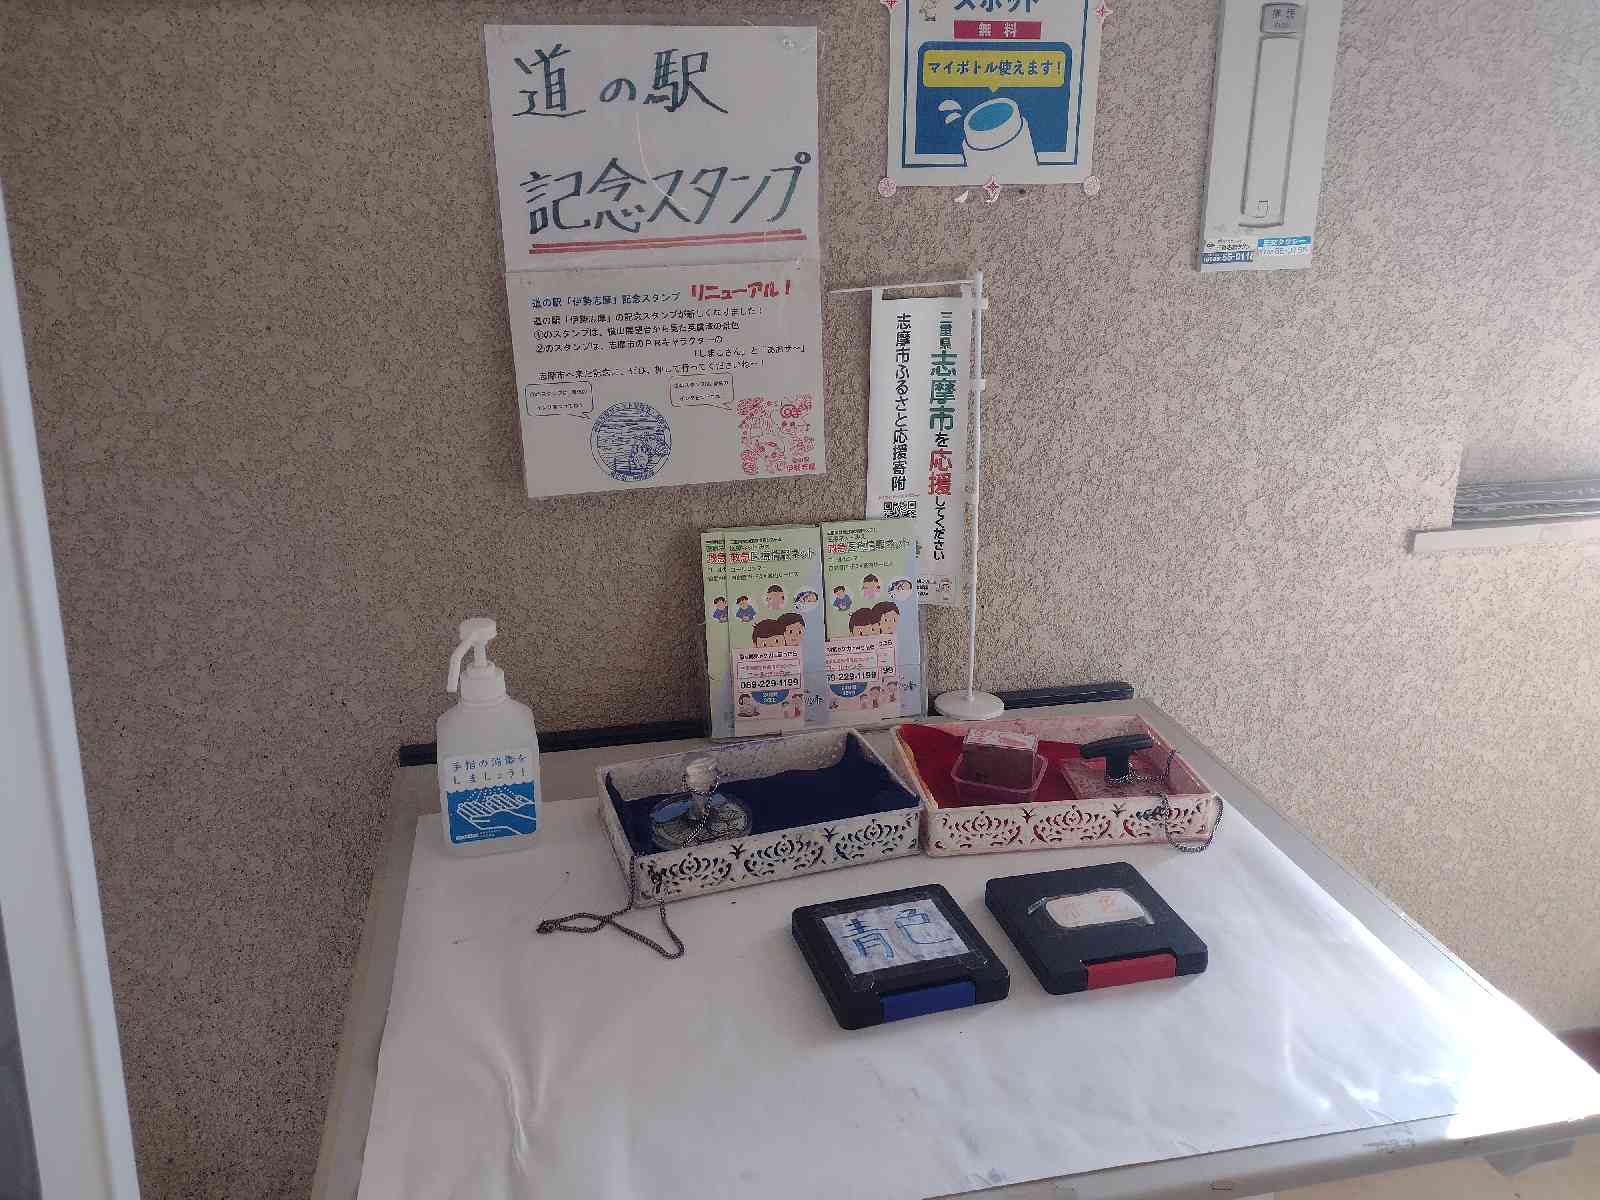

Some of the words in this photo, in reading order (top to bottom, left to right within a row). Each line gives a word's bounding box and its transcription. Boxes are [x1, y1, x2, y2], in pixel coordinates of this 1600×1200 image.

[512, 43, 728, 118] 道の駅
[927, 60, 1062, 75] マイボトル使えます！
[519, 151, 812, 235] 記念スタンプ
[690, 279, 792, 301] リニューアル！
[890, 313, 912, 491] 志摩市ふるさと応援寄附
[927, 311, 957, 561] 三重県志摩市を応援してください
[843, 907, 953, 962] 青色
